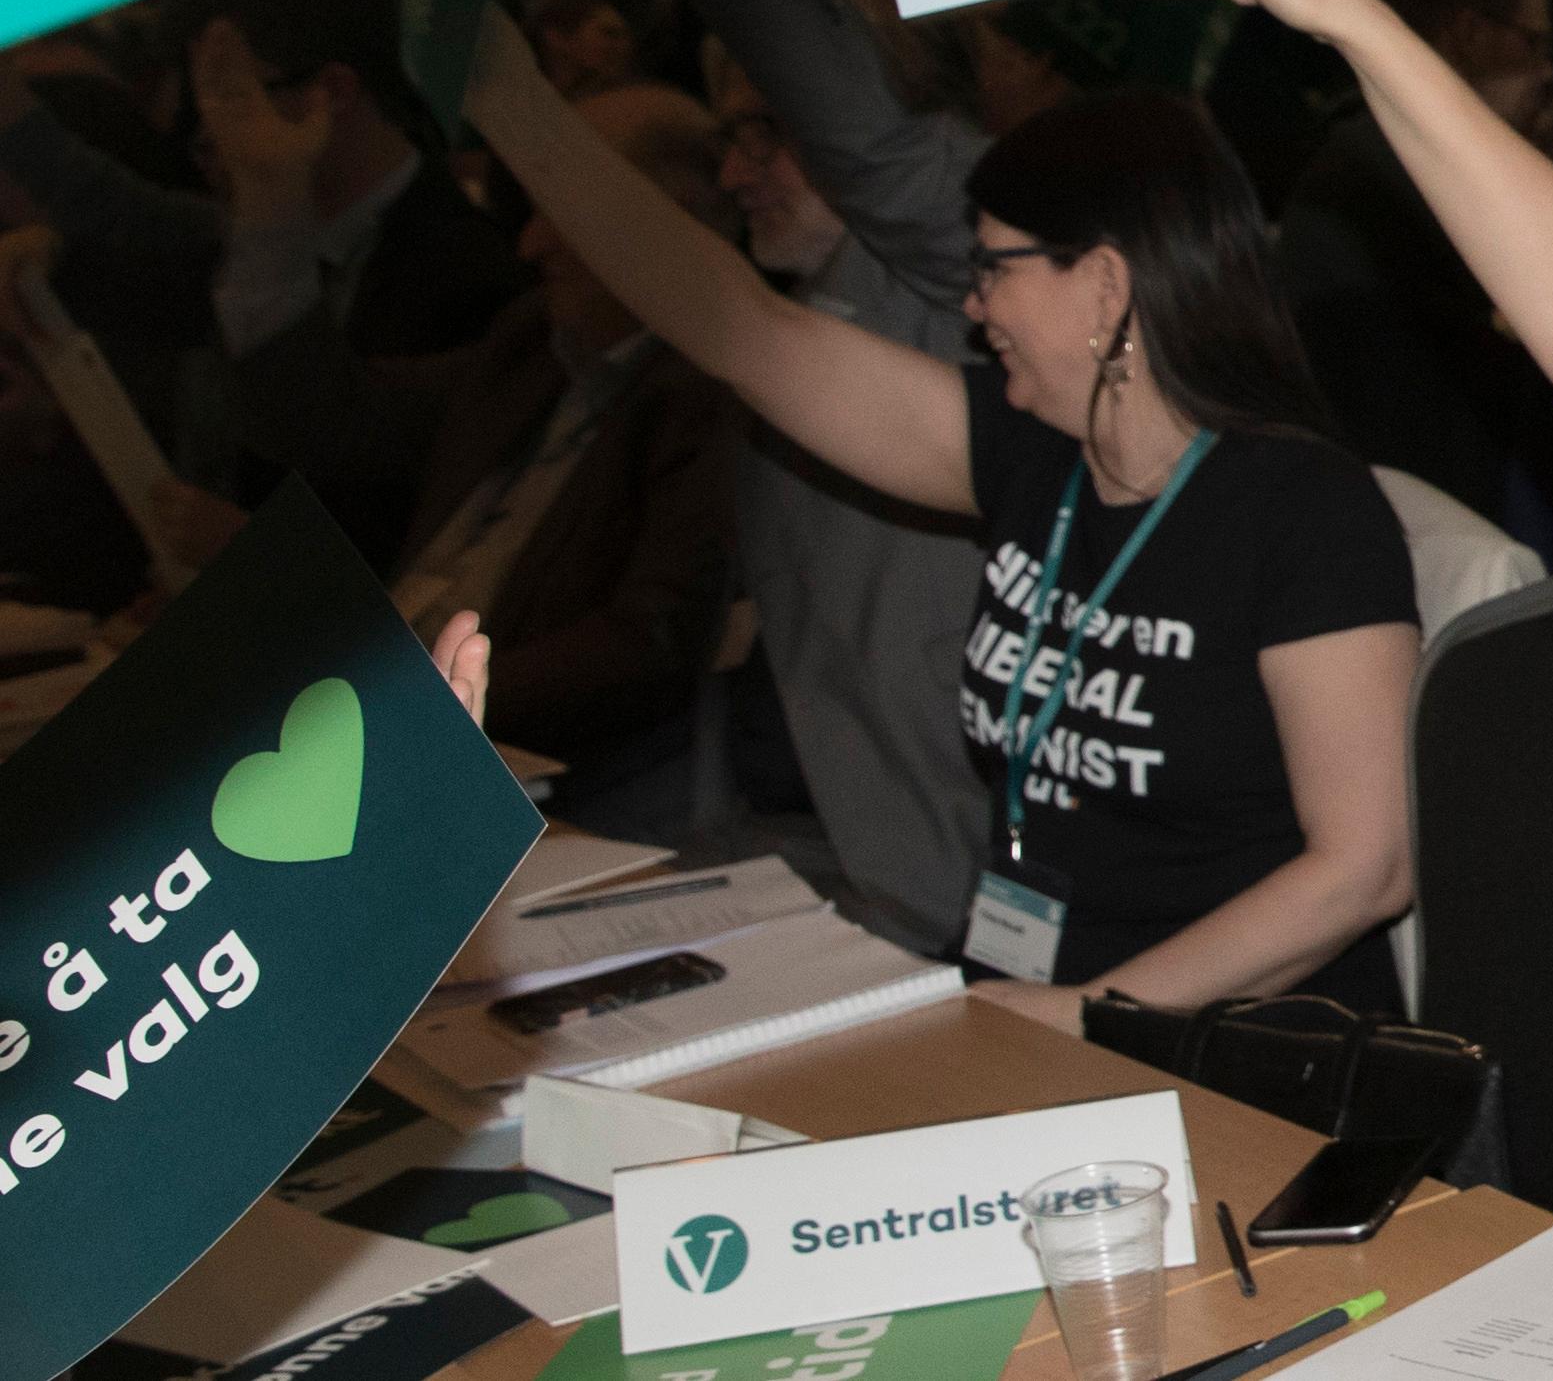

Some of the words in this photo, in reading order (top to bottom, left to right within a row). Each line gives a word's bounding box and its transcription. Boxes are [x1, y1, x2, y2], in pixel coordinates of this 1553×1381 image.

[43, 942, 109, 1012] å
[109, 848, 212, 943] ta
[73, 929, 260, 1101] valg
[790, 1176, 1122, 1254] Sentralstret
